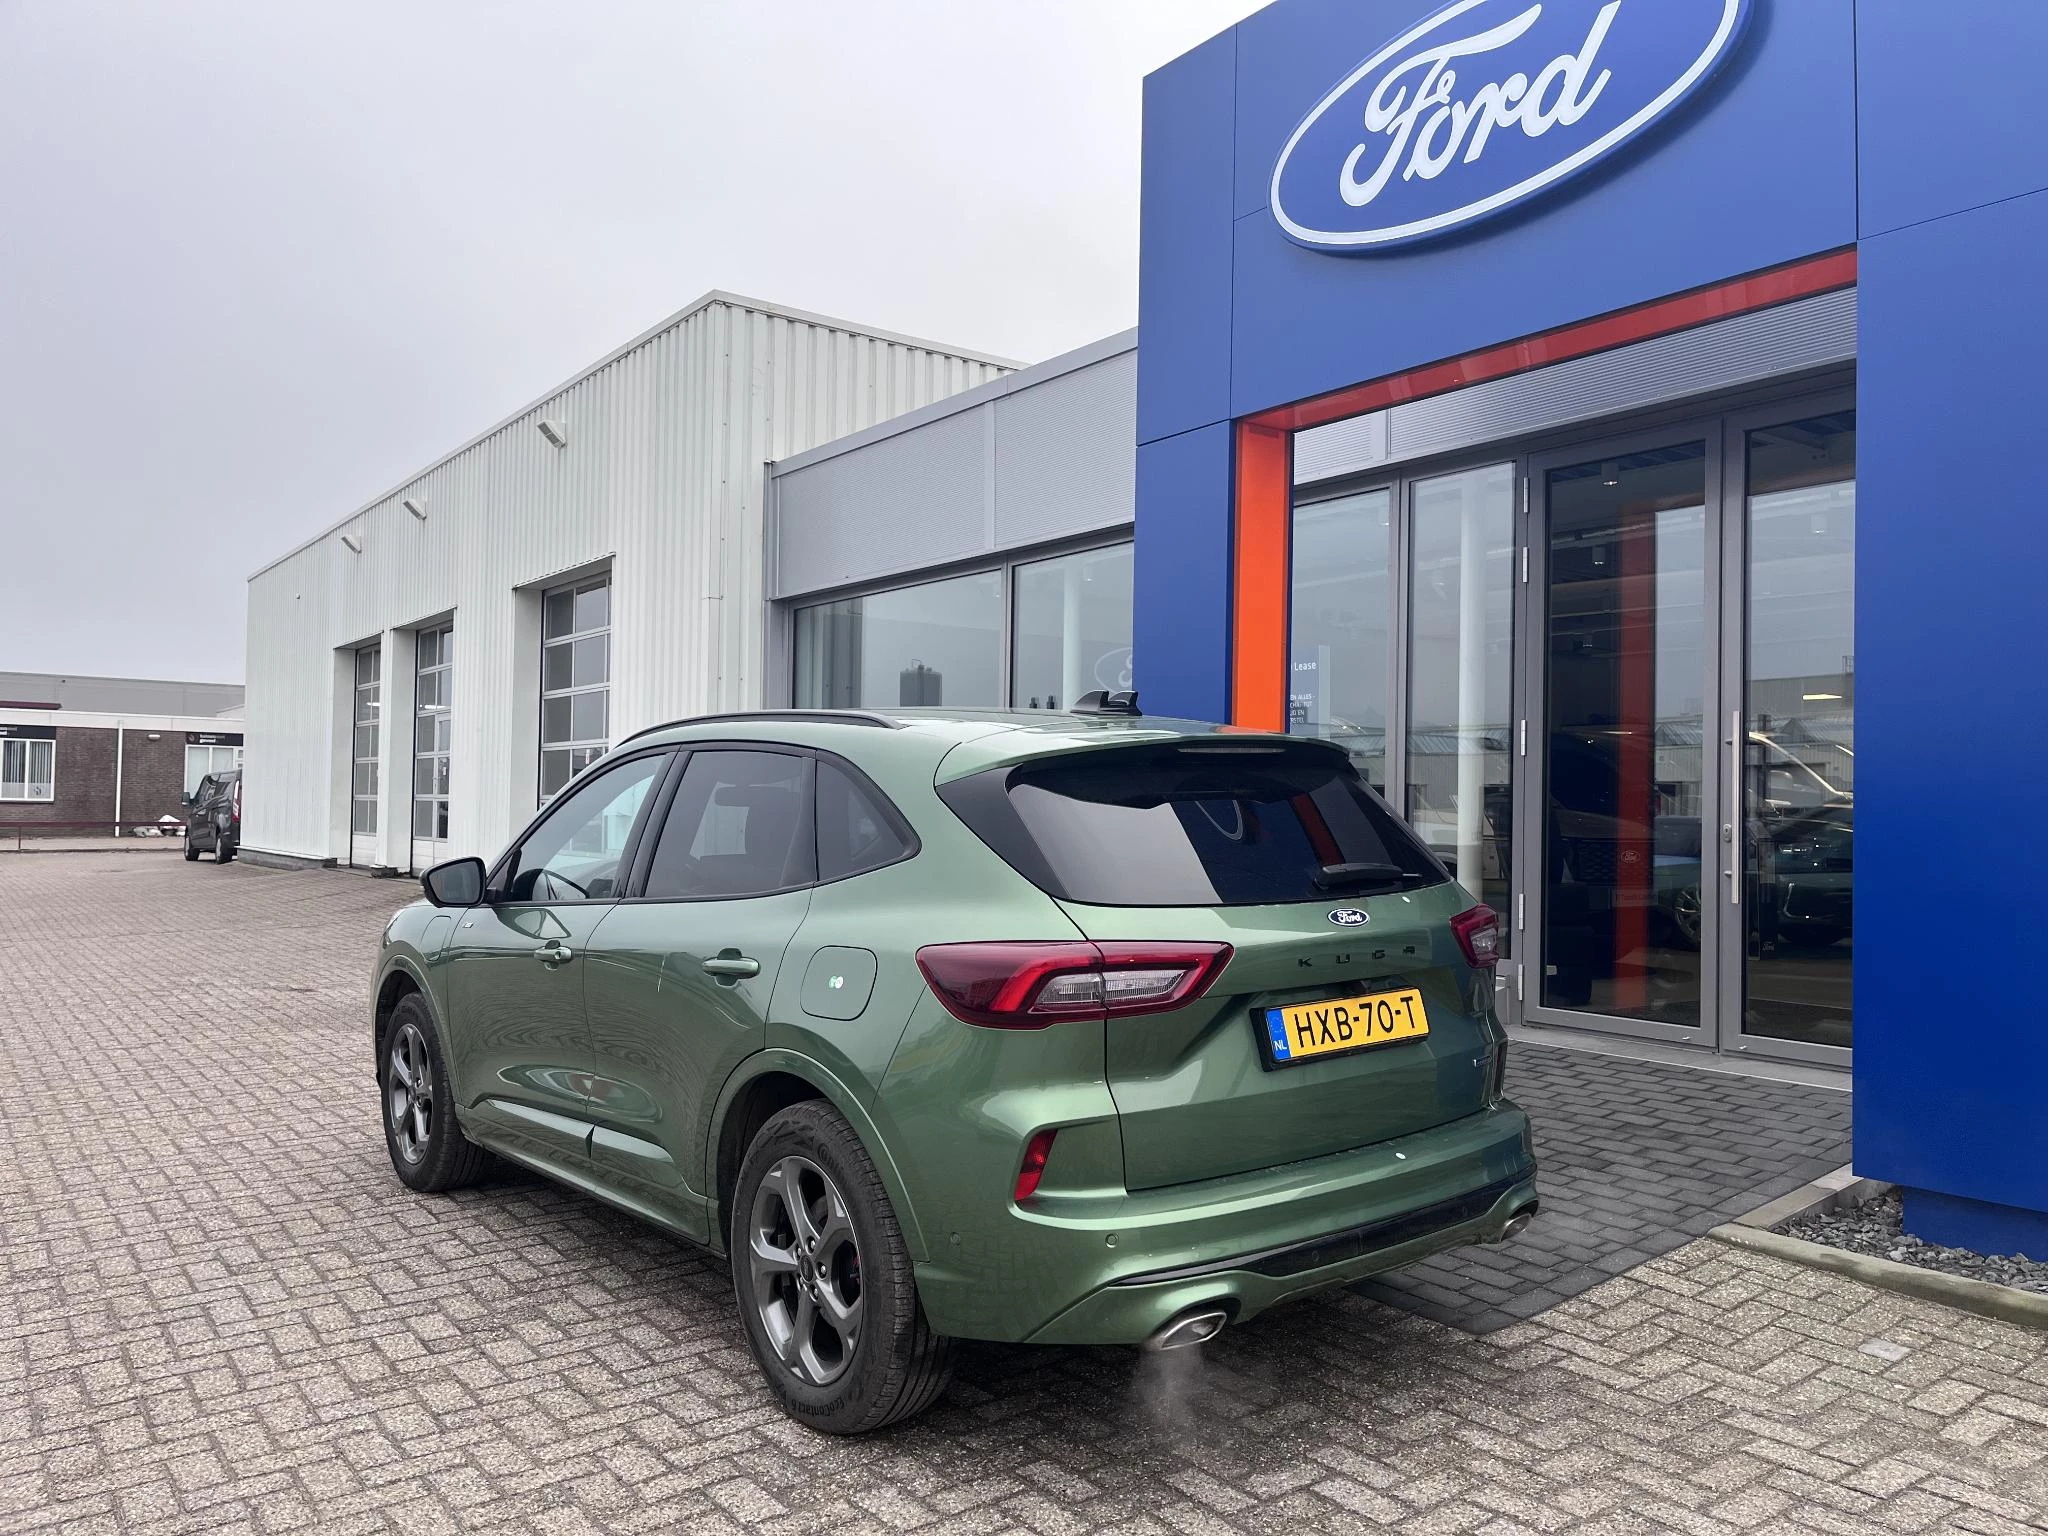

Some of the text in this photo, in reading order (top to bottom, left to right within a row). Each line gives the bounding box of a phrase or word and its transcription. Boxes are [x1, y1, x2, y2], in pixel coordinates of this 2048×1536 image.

[1340, 0, 1612, 206] Ford
[1294, 662, 1317, 671] Lease
[1336, 911, 1363, 923] Ford
[1297, 945, 1416, 968] KUGA
[1294, 996, 1416, 1048] HXB-70-T
[1274, 1041, 1288, 1051] NL
